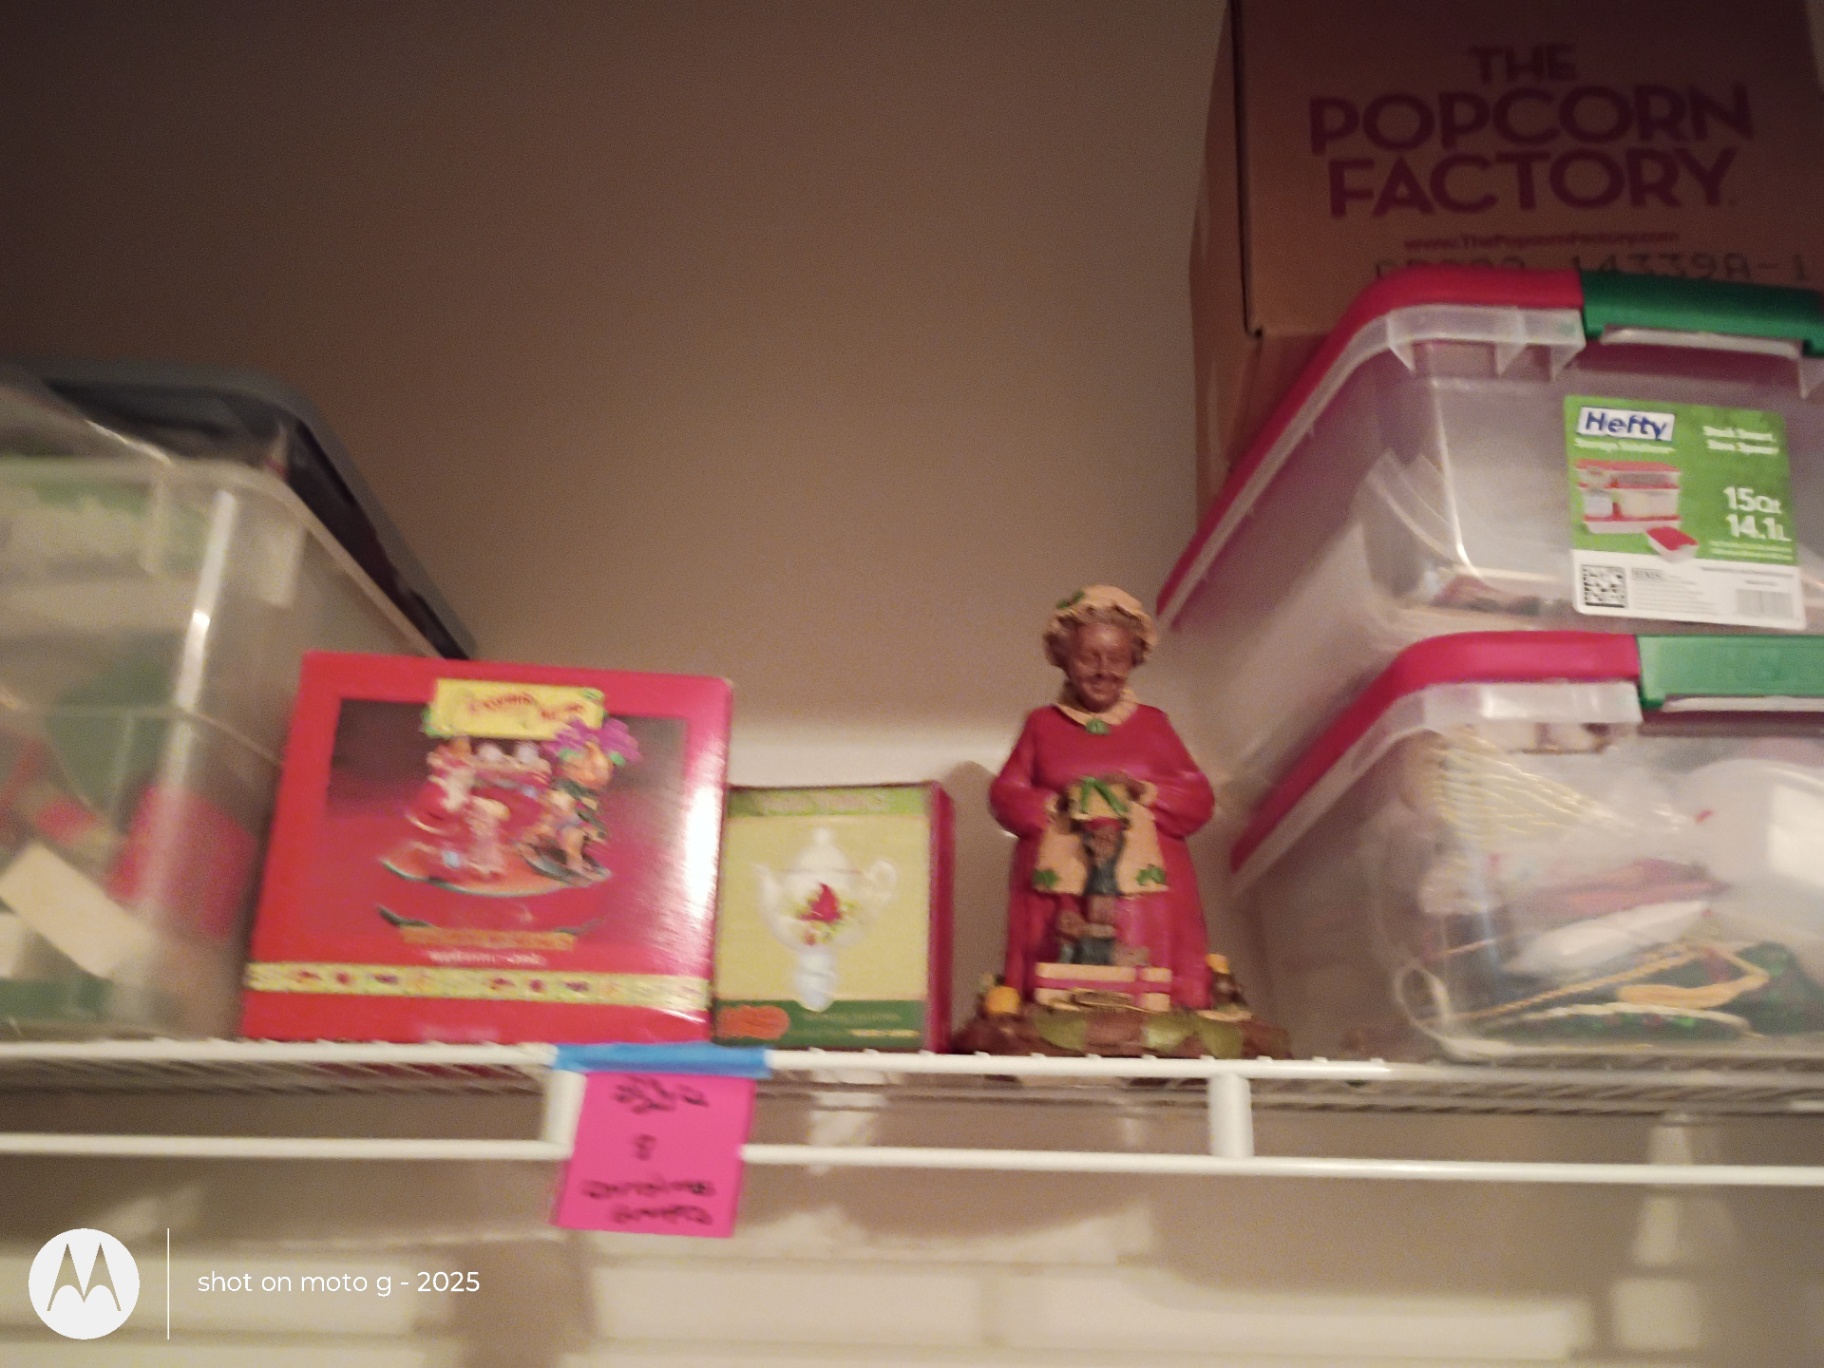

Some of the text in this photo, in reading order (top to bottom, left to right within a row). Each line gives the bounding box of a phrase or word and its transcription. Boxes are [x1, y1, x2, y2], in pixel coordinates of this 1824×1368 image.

[1467, 42, 1579, 86] THE
[1308, 82, 1754, 156] POPCORN
[1327, 147, 1739, 219] FACTORY
[1585, 411, 1668, 441] Hefty
